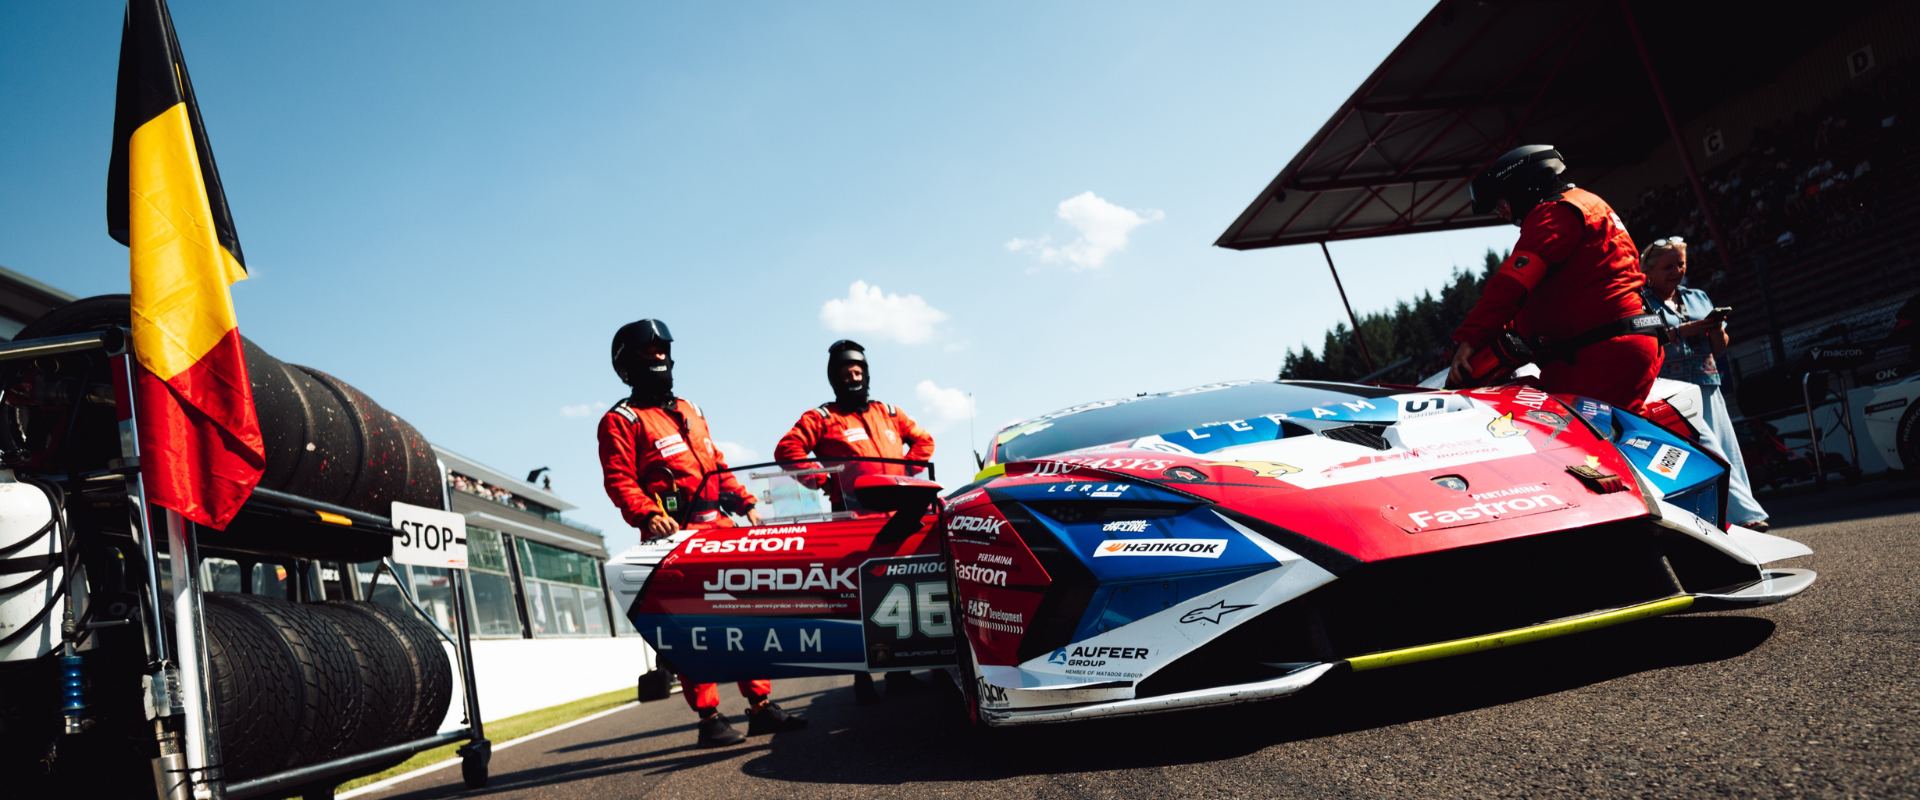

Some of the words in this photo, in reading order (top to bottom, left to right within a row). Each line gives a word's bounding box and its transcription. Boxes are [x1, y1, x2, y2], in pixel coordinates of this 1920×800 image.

[1851, 51, 1868, 74] D
[1708, 134, 1720, 152] C
[1823, 348, 1862, 358] macron
[1186, 399, 1377, 440] LERAM
[1473, 485, 1546, 501] PERTAMINA
[1408, 492, 1564, 529] Fastron
[400, 520, 453, 551] STOP
[748, 525, 807, 536] PERTAMINA
[685, 536, 805, 554] Fastron
[977, 553, 1012, 566] PERTAMINA
[954, 559, 1007, 587] Fastron
[870, 581, 955, 639] 46
[967, 599, 990, 618] FAST
[989, 607, 1023, 623] Development
[656, 626, 822, 653] LERAM
[1070, 646, 1150, 660] AUFEER
[1068, 659, 1106, 668] GROUP
